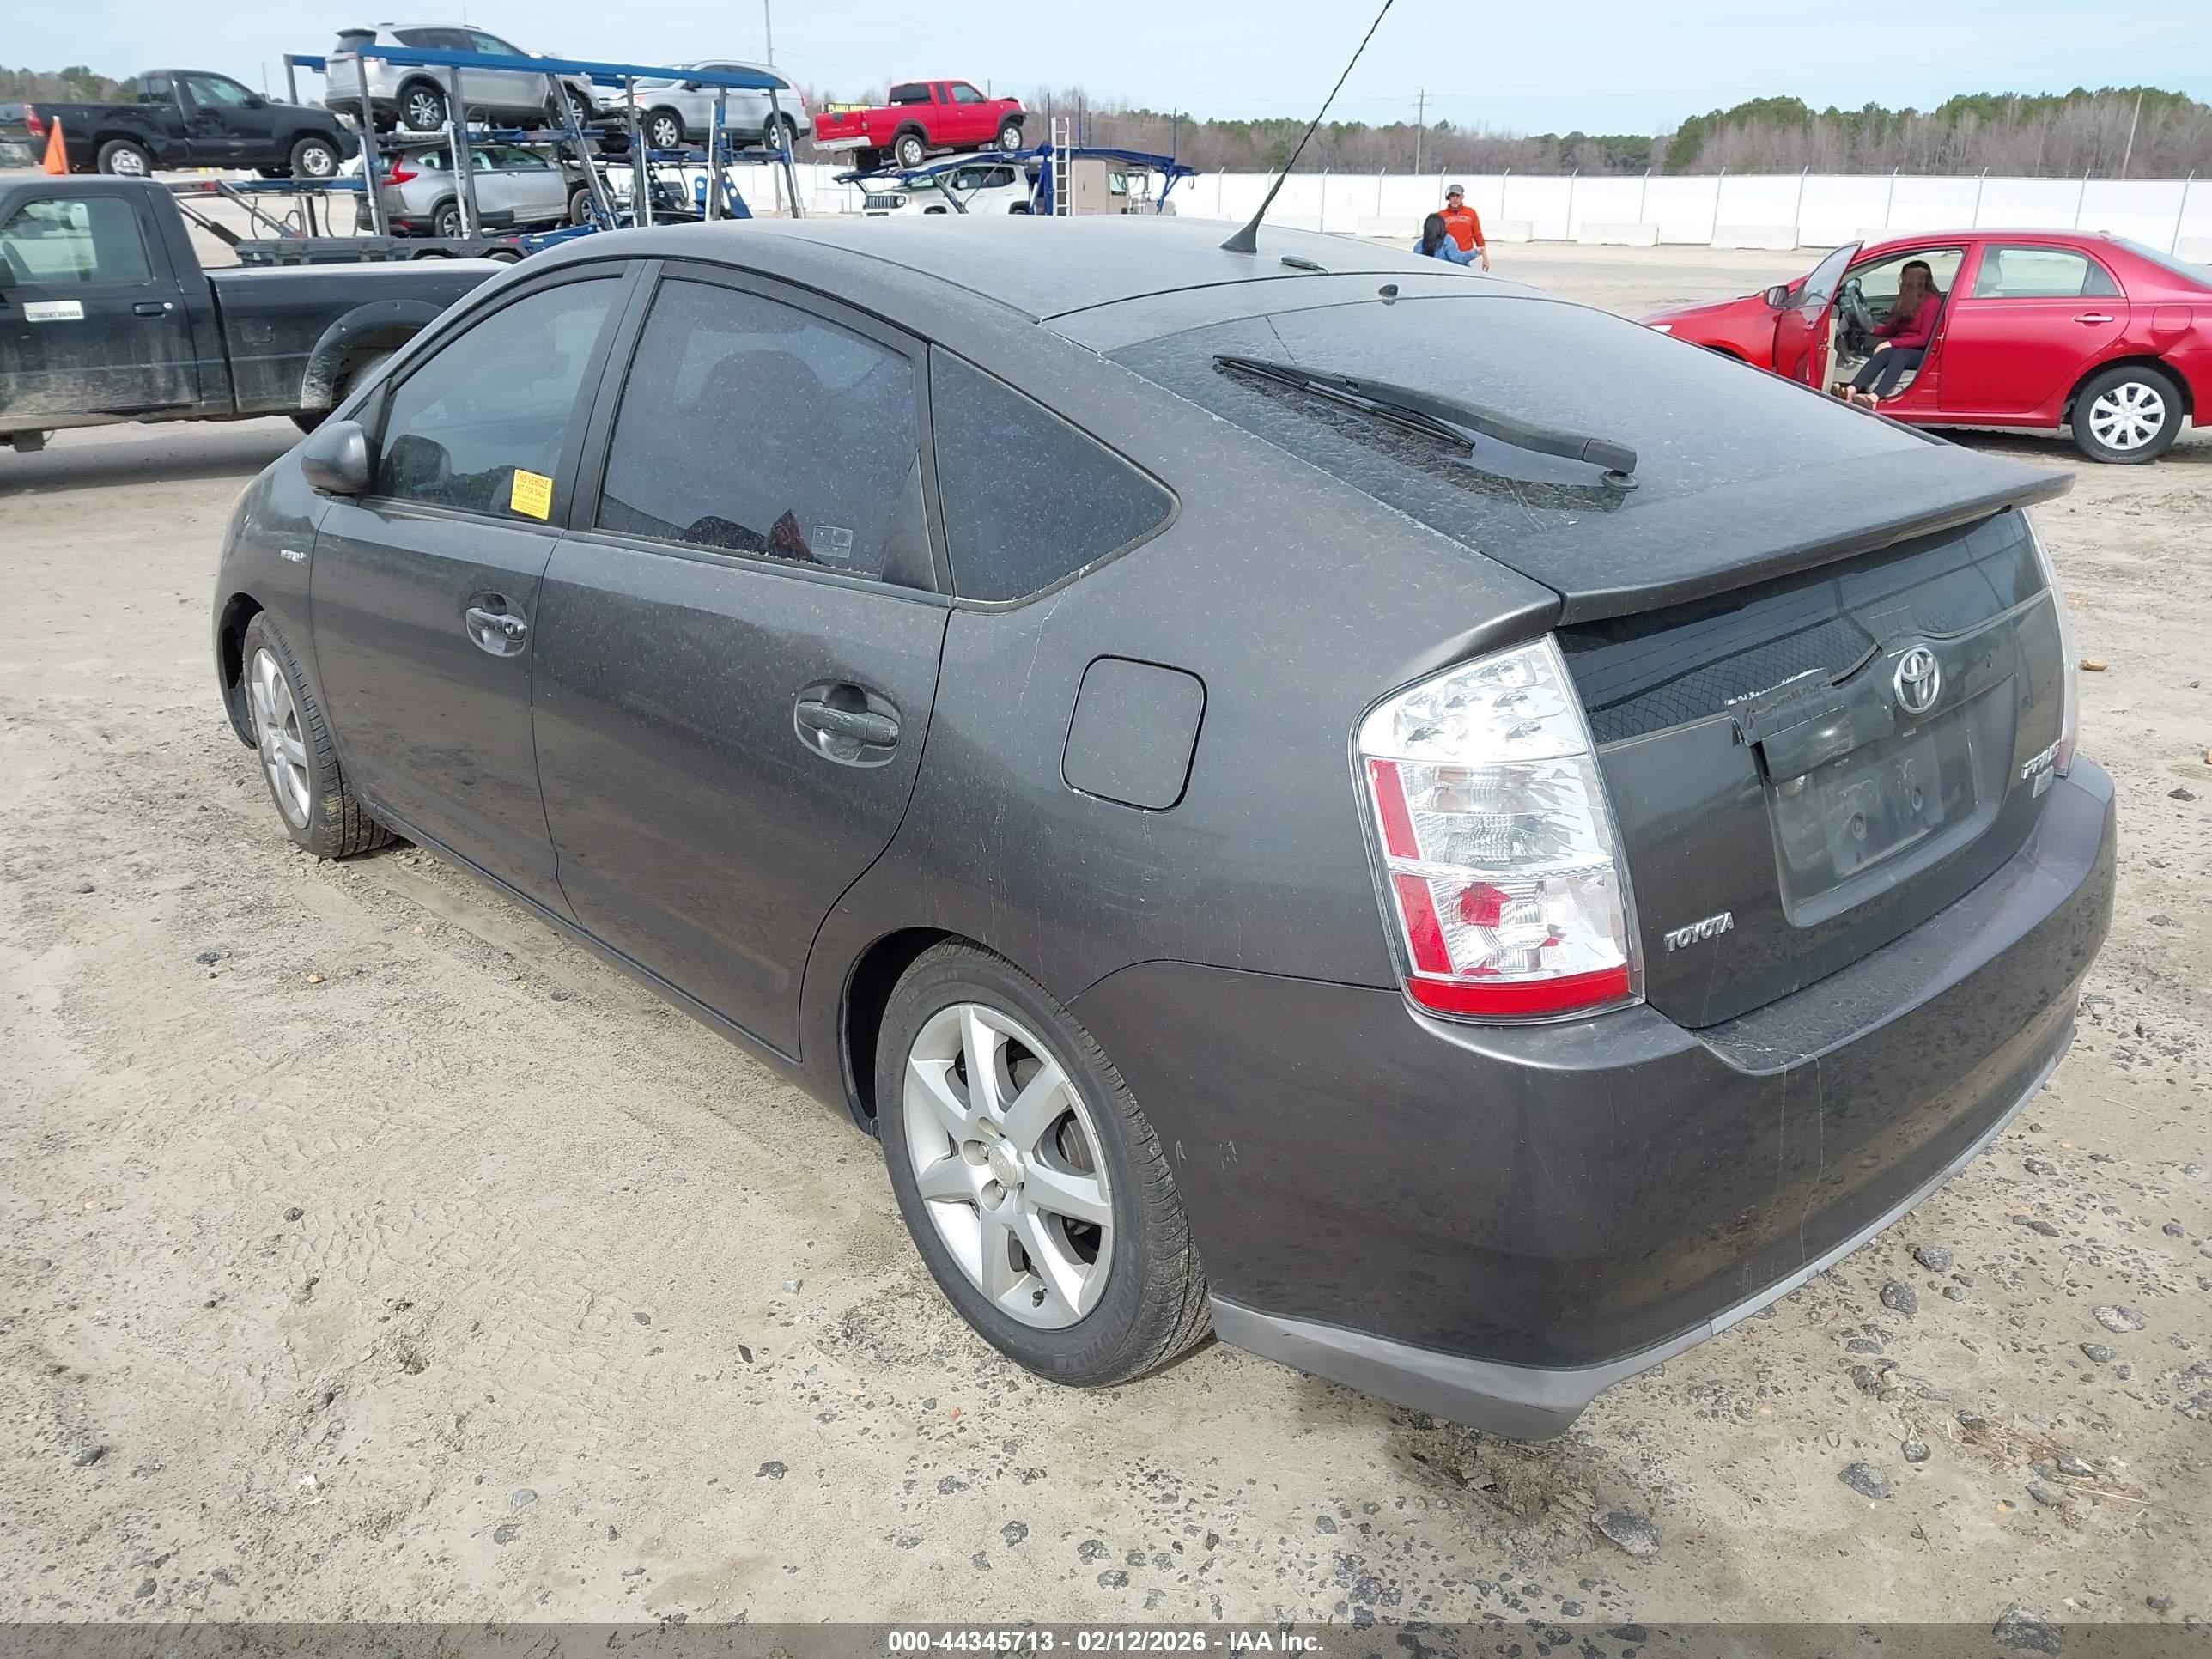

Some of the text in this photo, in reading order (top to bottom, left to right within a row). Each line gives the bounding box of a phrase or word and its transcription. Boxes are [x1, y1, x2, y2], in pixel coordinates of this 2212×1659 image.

[528, 475, 549, 489] VEHICLE
[534, 489, 546, 499] SALE
[1663, 911, 1735, 952] TOYOTA
